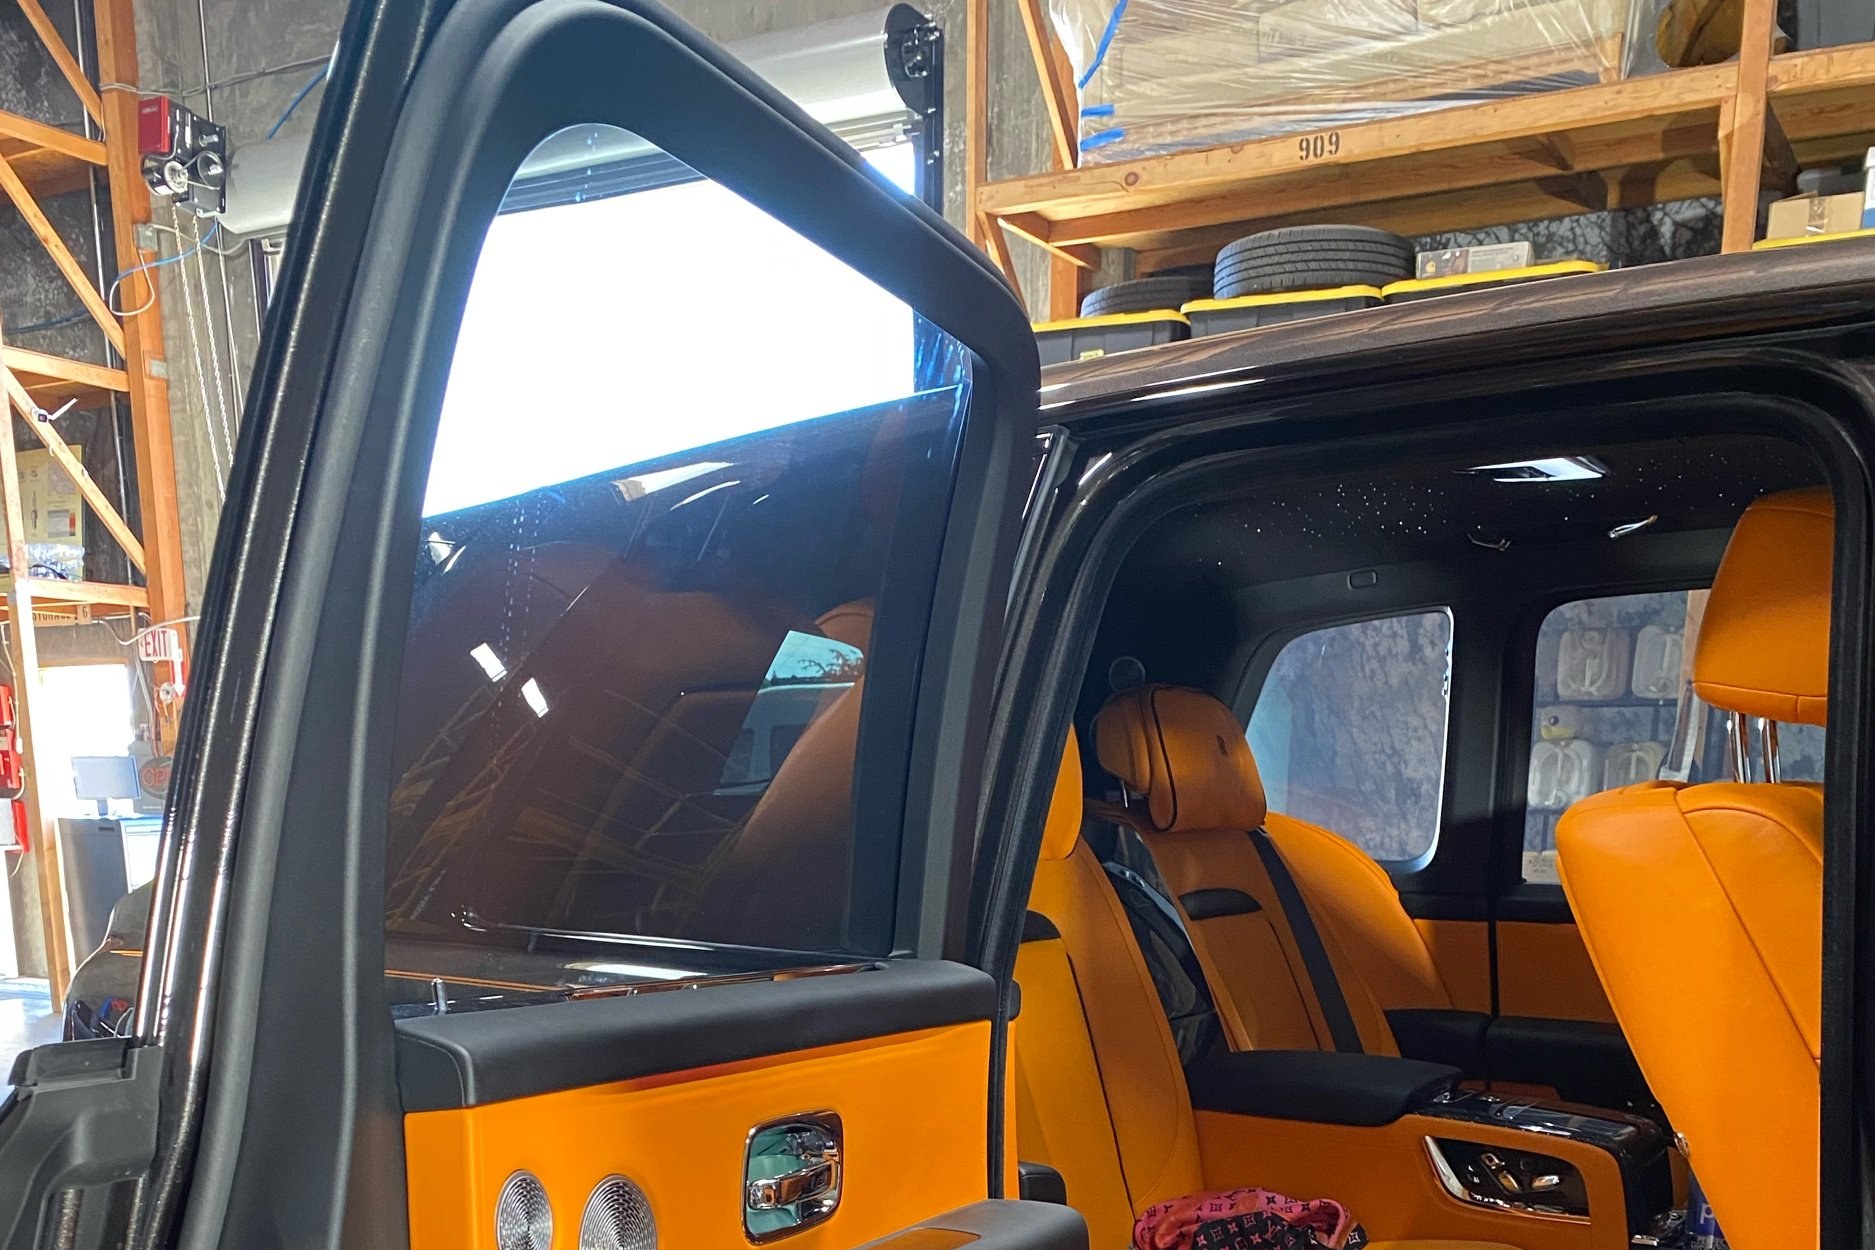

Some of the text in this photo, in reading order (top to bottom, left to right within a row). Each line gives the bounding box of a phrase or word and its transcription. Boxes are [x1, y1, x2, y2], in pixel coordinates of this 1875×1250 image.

[1299, 131, 1340, 161] 909
[144, 630, 168, 657] EXIT
[141, 766, 171, 787] OP
